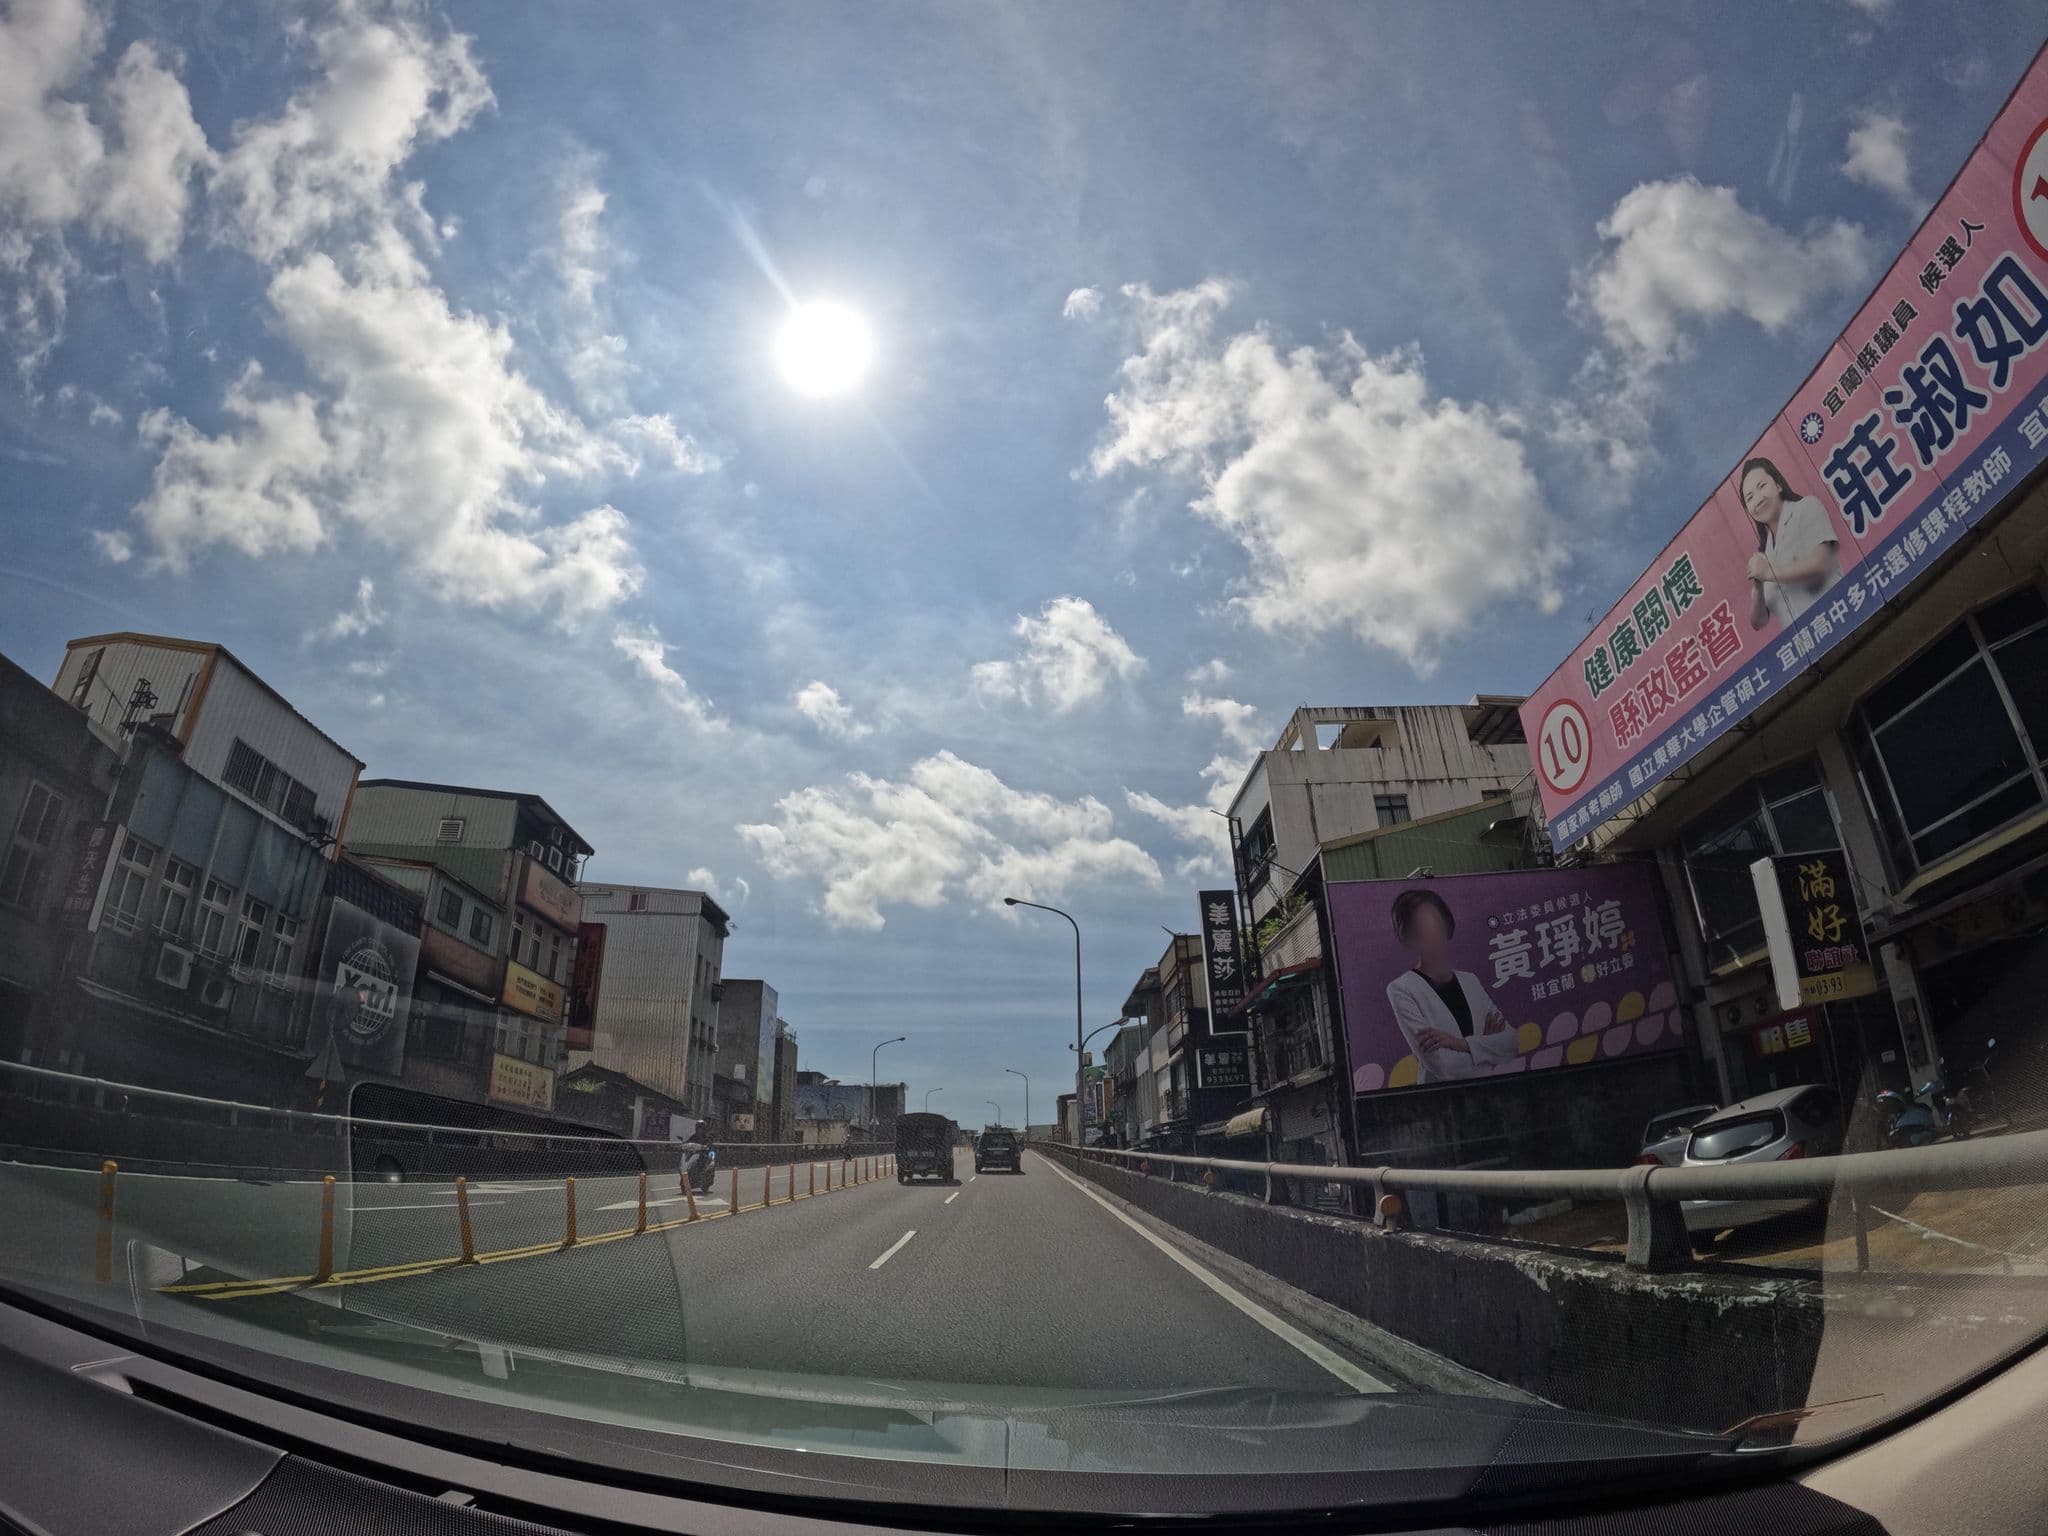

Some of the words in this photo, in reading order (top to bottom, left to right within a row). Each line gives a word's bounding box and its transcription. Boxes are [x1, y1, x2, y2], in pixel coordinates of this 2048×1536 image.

[1822, 299, 1919, 418] 宜蘭縣議員
[1920, 218, 1984, 294] 候選人
[1823, 255, 2048, 534] 莊淑如
[1584, 553, 1703, 699] 健康關懷
[1608, 600, 1743, 748] 縣政監督
[1544, 715, 1582, 780] 10
[1208, 902, 1236, 980] 美麗莎
[1797, 859, 1848, 942] 滿好
